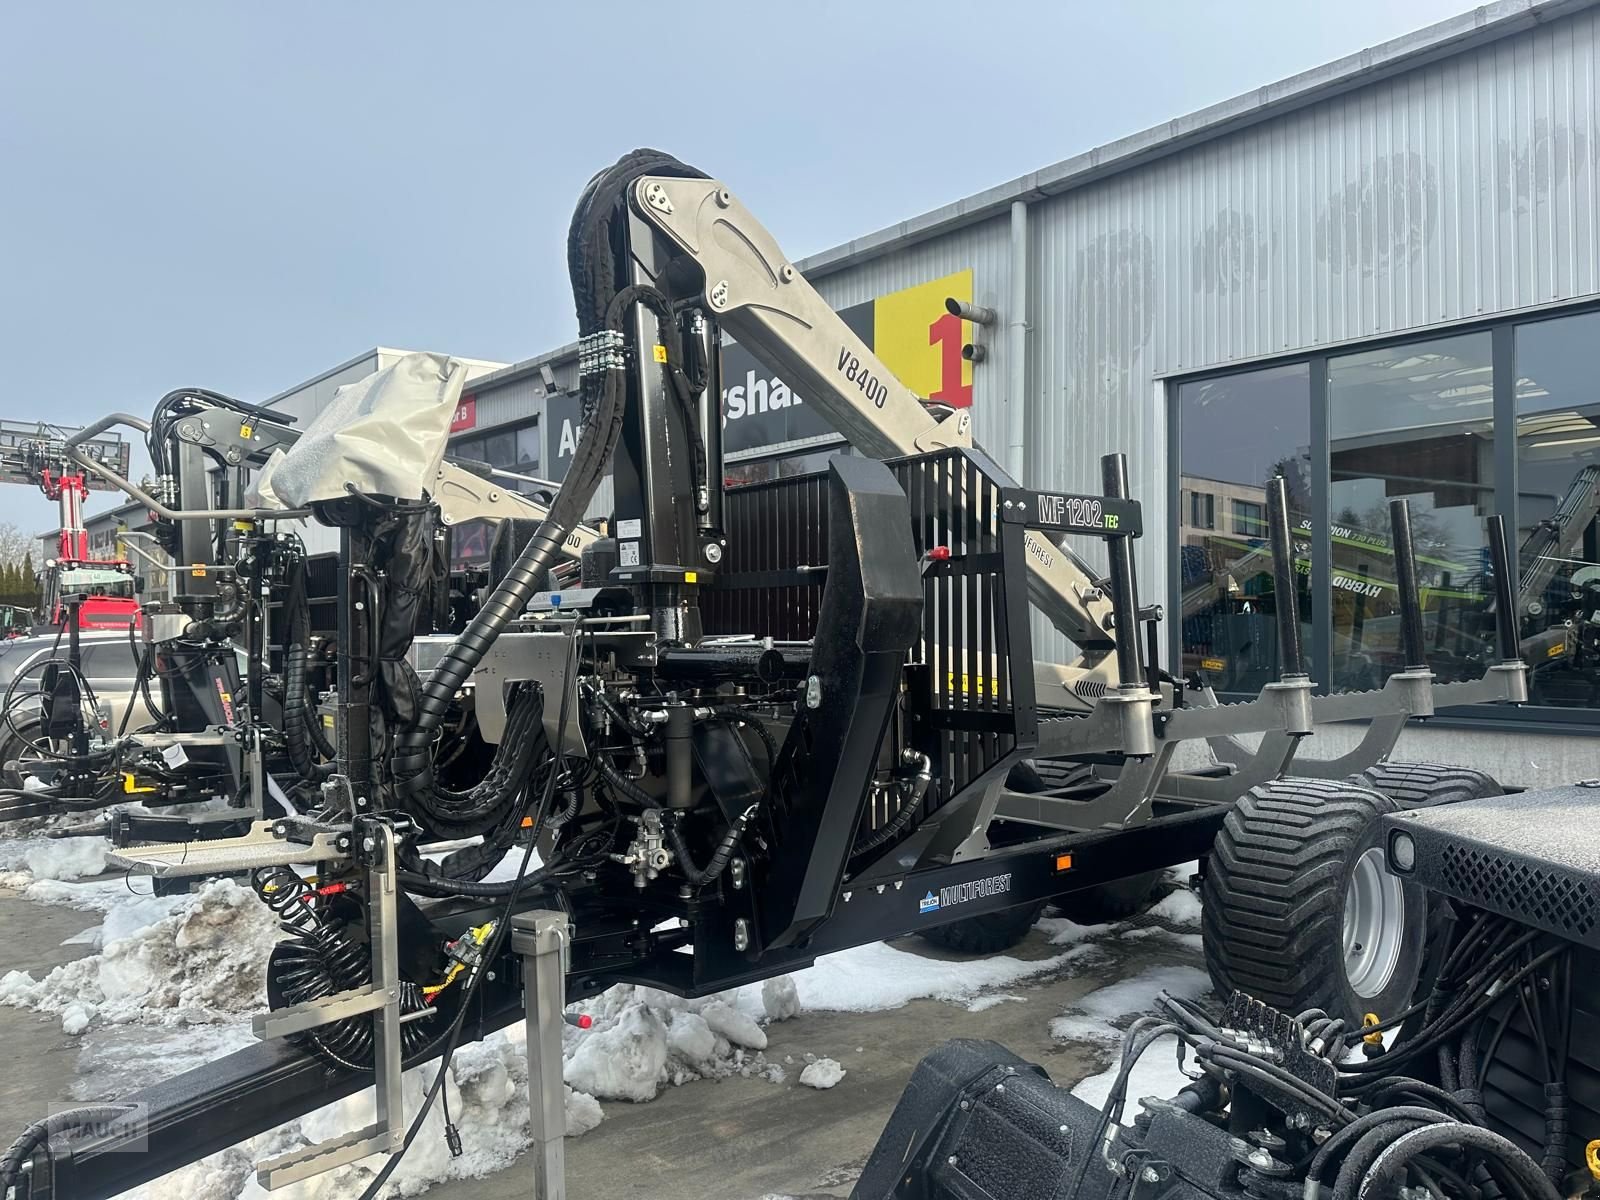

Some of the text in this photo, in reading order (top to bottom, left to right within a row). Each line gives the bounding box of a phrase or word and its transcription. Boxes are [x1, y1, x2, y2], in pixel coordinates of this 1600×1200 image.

[837, 346, 888, 408] V8400
[929, 313, 973, 409] 1
[1038, 495, 1119, 528] MF 1202 TEC
[1351, 533, 1367, 542] 730
[1367, 538, 1388, 547] PLUS
[1332, 576, 1382, 598] HYBRID
[941, 873, 1012, 907] MULTIFOREST
